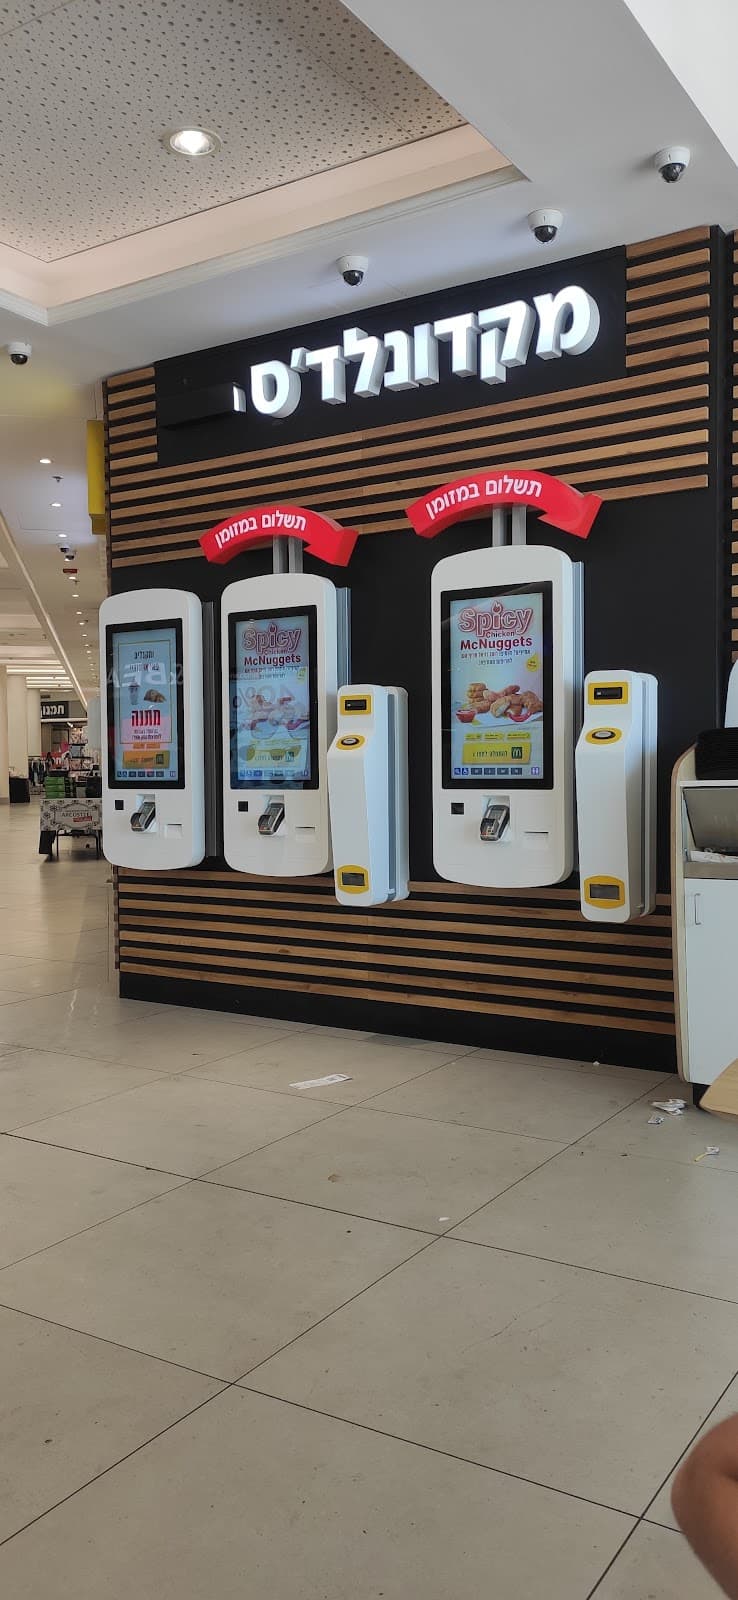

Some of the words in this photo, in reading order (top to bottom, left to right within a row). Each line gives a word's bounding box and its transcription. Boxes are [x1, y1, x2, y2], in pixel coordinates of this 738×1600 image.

[485, 475, 542, 499] תשלום
[424, 485, 480, 520] במזומן
[215, 516, 258, 549] במזומן
[261, 510, 307, 532] תשלום
[458, 601, 533, 637] Spicy
[243, 622, 301, 653] Spicy
[460, 637, 533, 650] McNuggets
[244, 654, 301, 666] McNuggets
[131, 709, 161, 727] מתנה
